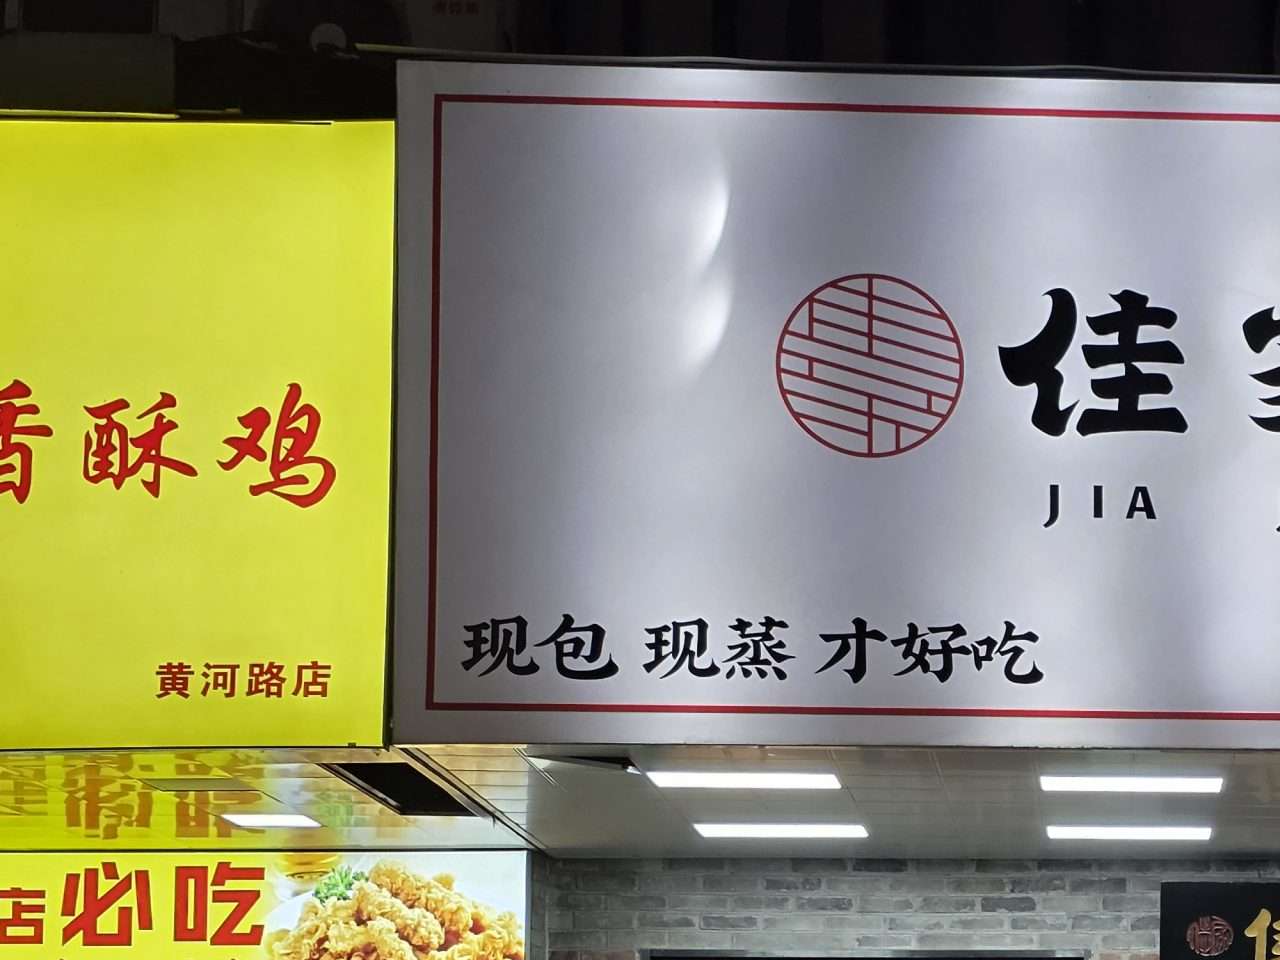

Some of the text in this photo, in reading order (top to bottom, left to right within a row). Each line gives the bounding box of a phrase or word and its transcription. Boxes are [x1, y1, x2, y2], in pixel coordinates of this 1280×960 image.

[1043, 484, 1158, 529] JIA
[461, 613, 1045, 684] 现包 现蒸 才好吃
[155, 661, 332, 699] 黄河路店
